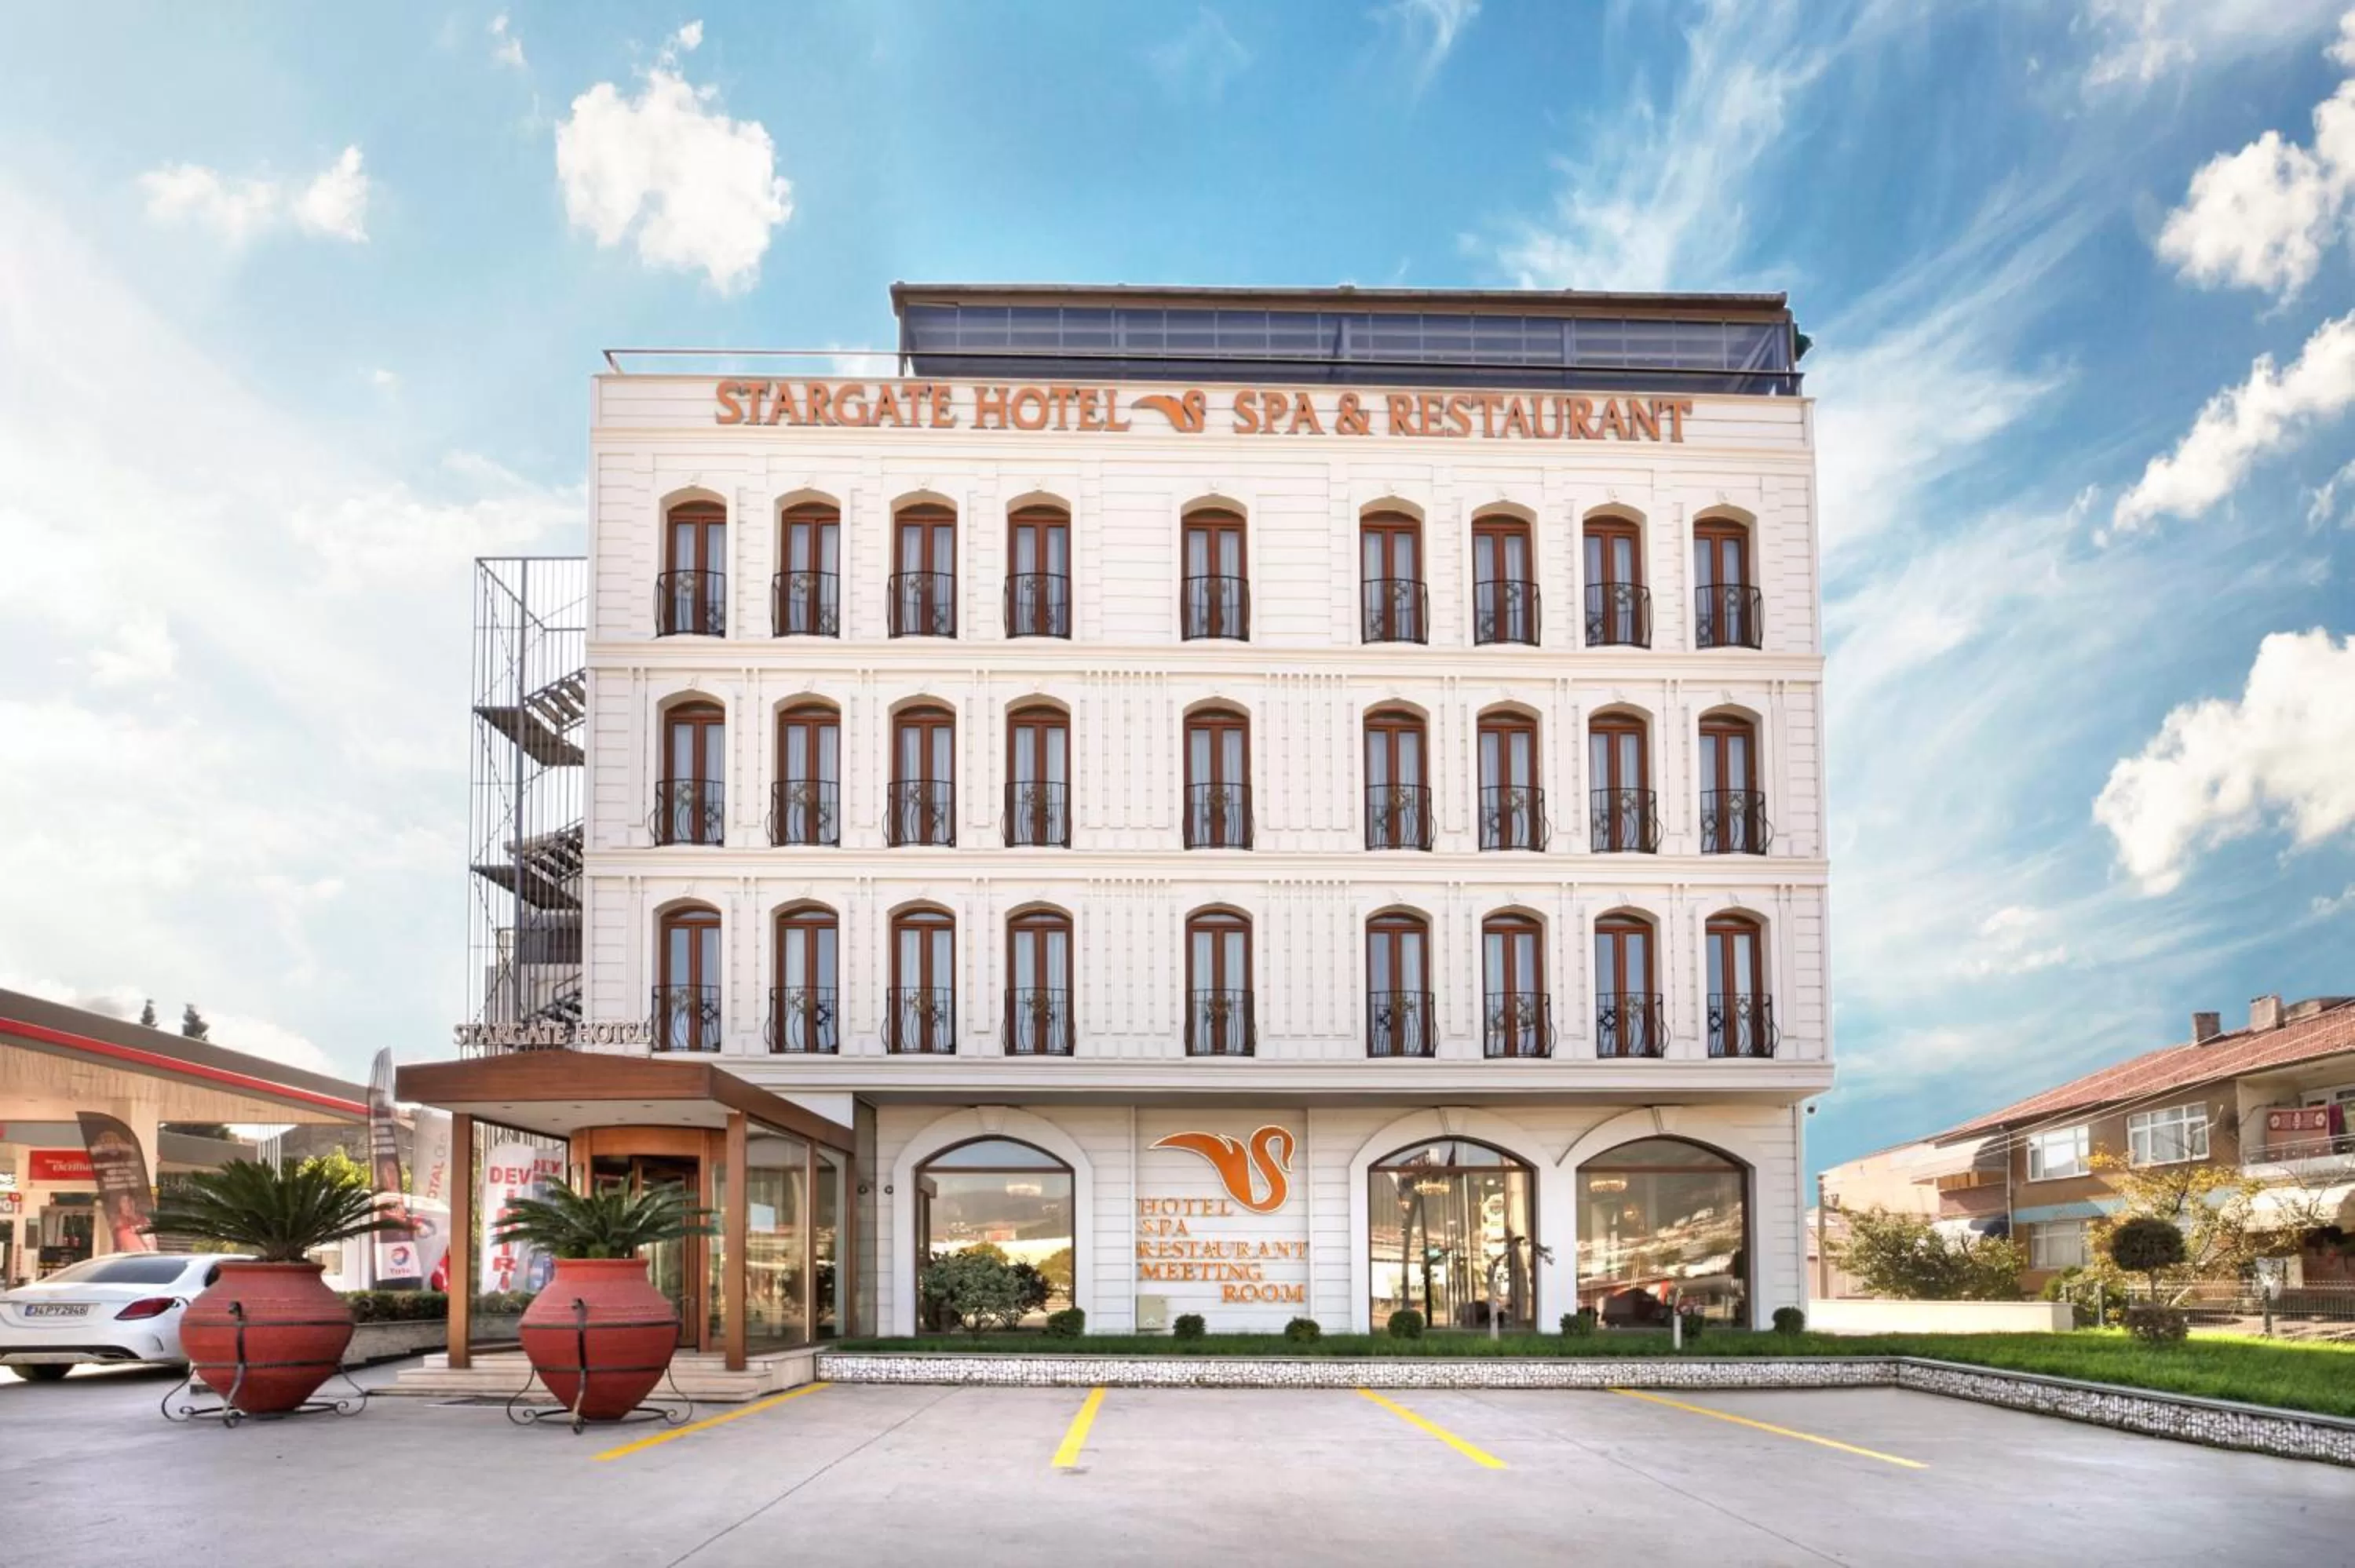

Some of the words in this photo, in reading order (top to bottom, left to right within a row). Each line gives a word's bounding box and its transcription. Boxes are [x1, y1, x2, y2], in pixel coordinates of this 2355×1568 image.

[715, 379, 958, 428] STARGATE
[969, 385, 1130, 432] HOTEL
[1232, 389, 1327, 436] SPA
[1334, 392, 1374, 436] &
[1386, 393, 1693, 443] RESTAURANT
[453, 1022, 568, 1045] STARGATE
[575, 1020, 652, 1045] HOTEL
[489, 1166, 536, 1184] DEV
[1136, 1197, 1234, 1216] HOTEL
[1140, 1218, 1191, 1237] SPA
[1135, 1240, 1309, 1260] RESTAURANT
[1137, 1261, 1265, 1282] MEETING
[1221, 1283, 1307, 1304] ROOM
